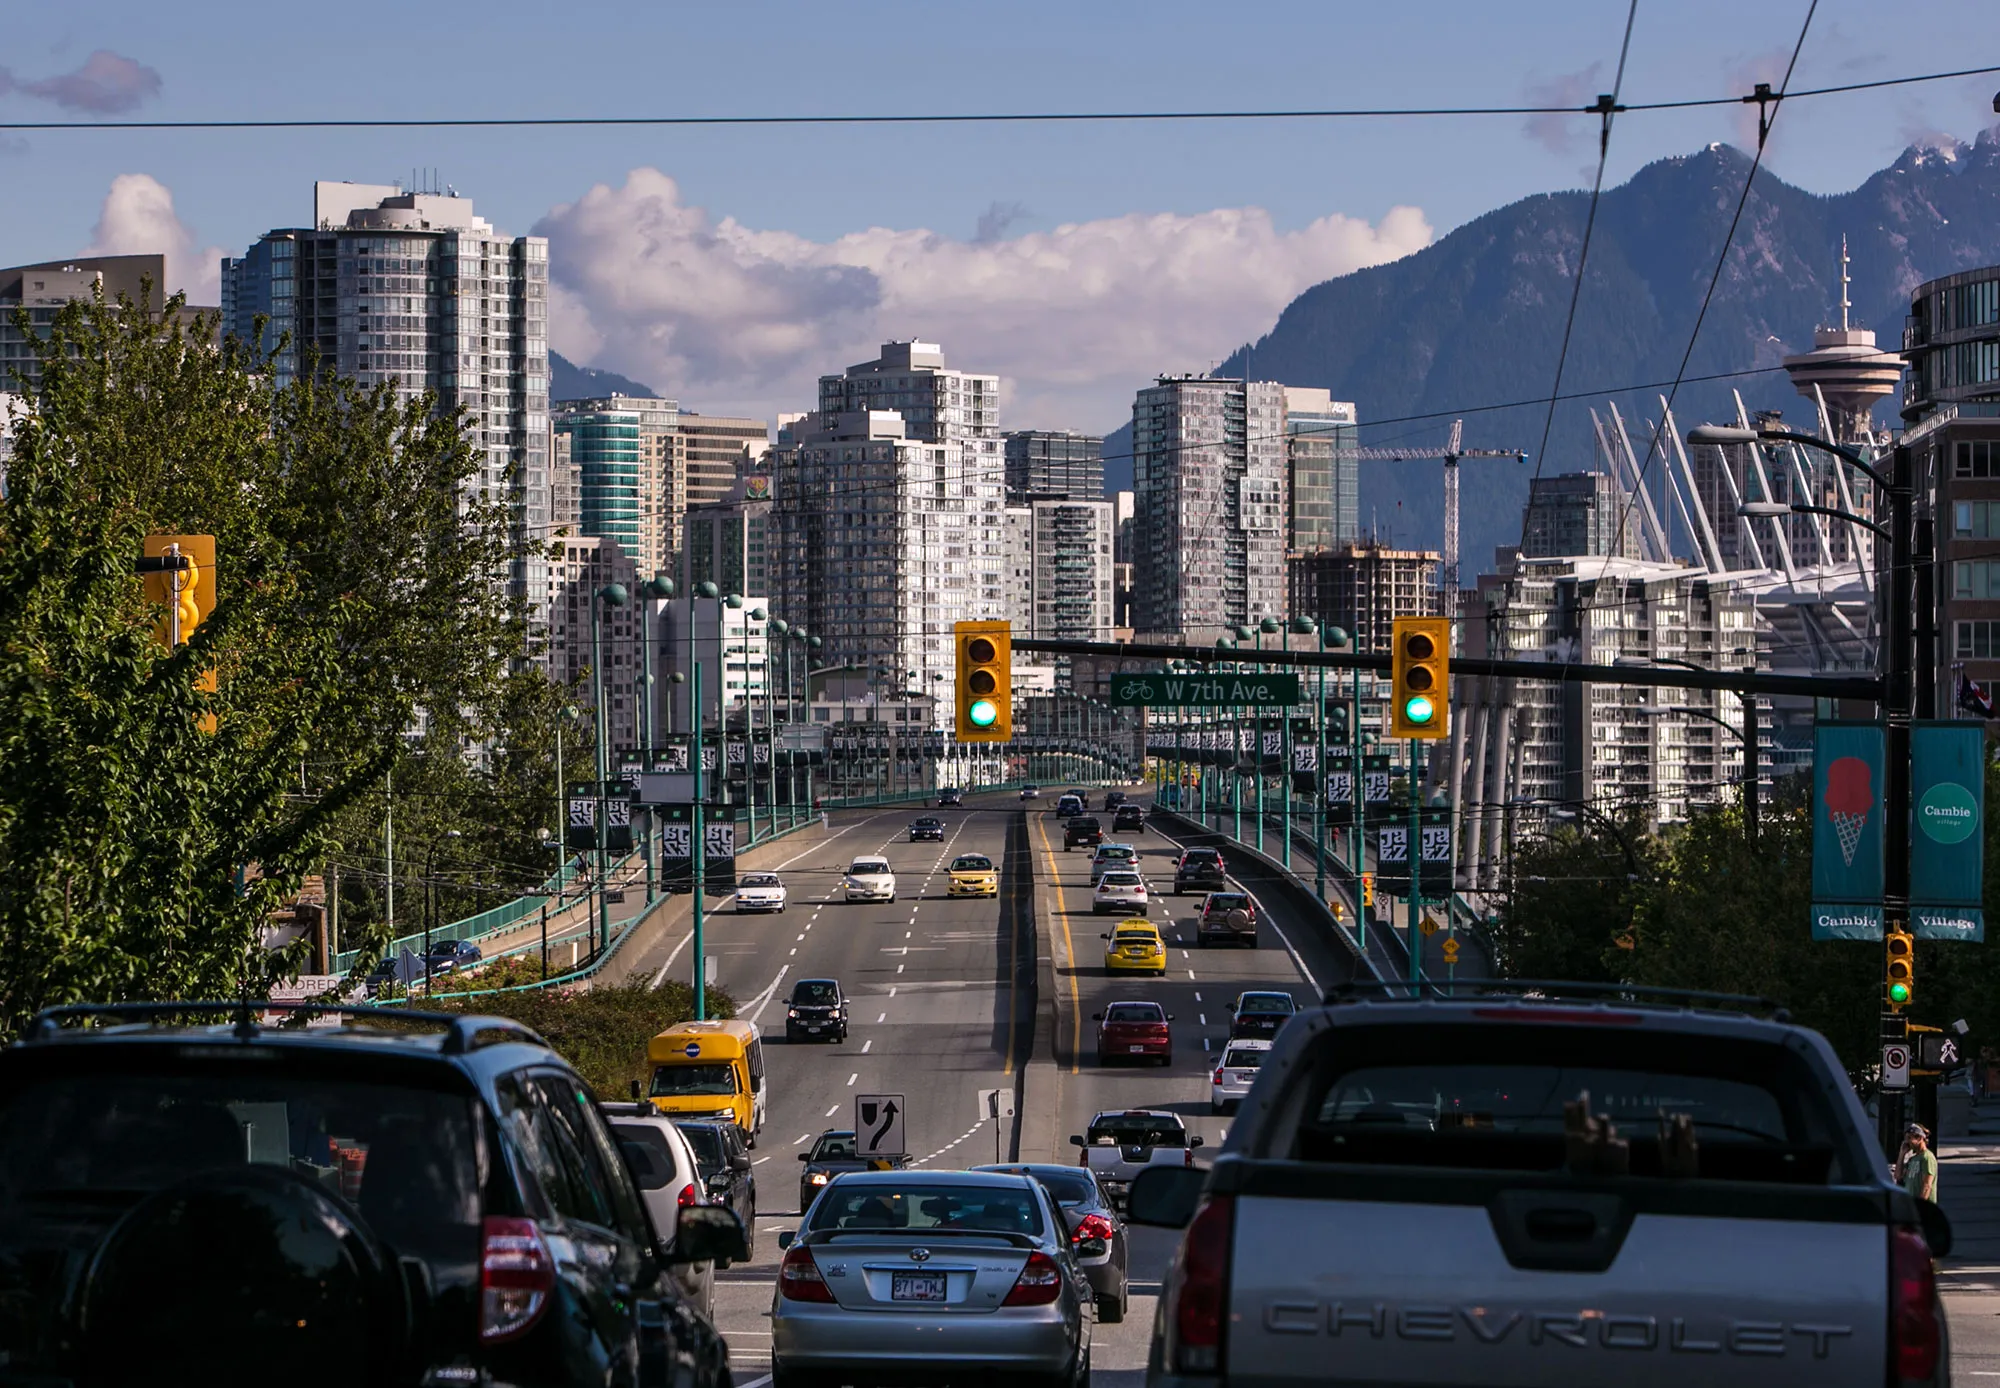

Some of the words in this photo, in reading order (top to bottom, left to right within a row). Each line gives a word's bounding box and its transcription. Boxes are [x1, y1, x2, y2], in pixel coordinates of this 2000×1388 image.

[1165, 681, 1184, 700] W
[1190, 680, 1224, 702] 7th
[1231, 681, 1275, 700] Ave.
[1925, 805, 1971, 817] Cambie
[1818, 916, 1877, 927] Cambie
[1919, 917, 1975, 929] Village
[1262, 1301, 1852, 1359] CHEVROLET
